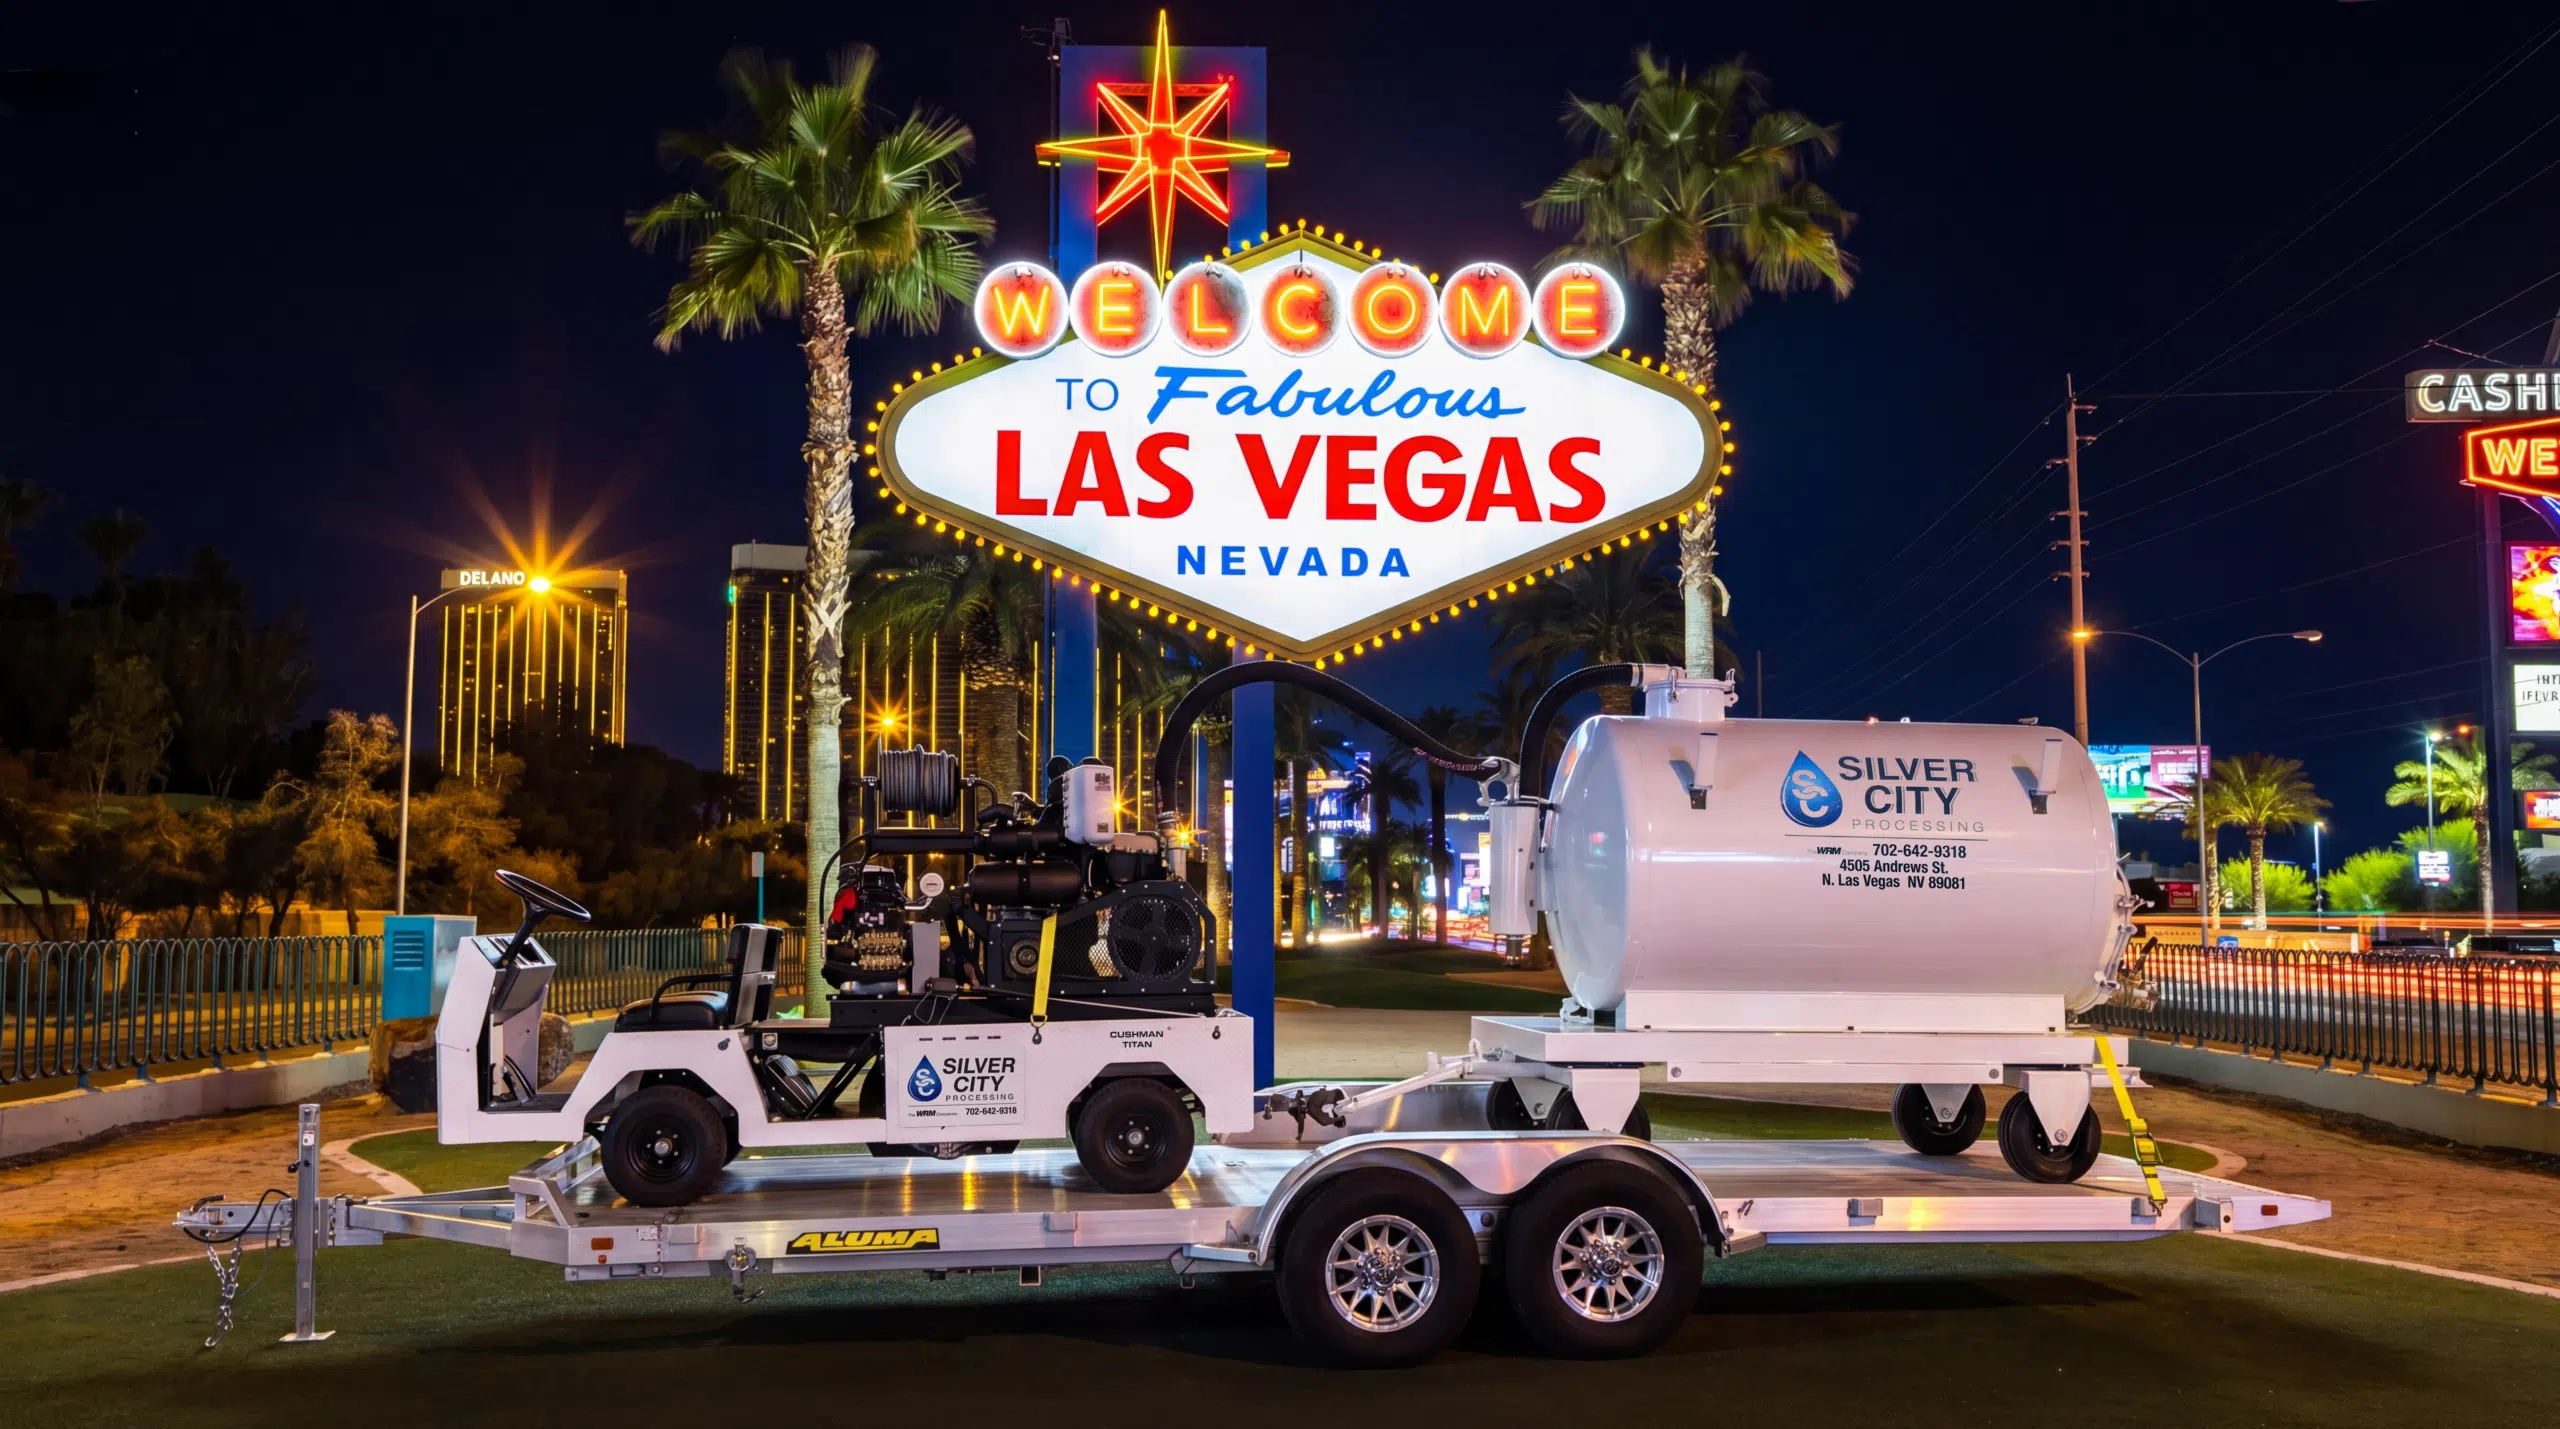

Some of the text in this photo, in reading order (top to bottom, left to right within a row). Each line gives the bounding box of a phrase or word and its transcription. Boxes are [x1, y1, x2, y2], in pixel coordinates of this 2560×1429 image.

[991, 283, 1599, 338] WELCOME
[1055, 365, 1527, 425] TO Fabulous
[2417, 372, 2560, 413] CASH
[2481, 438, 2560, 476] WE
[995, 429, 1607, 524] LAS VEGAS
[1176, 544, 1411, 578] NEVADA
[459, 571, 526, 586] DELANO
[1838, 756, 1979, 783] SILVER
[1864, 784, 1962, 816] CITY
[1851, 818, 1985, 833] PROCESSING
[1816, 846, 1842, 855] WRM
[1872, 843, 1967, 859] 702-642-9318
[1839, 858, 1949, 875] 4505 Andrews St.
[1822, 873, 1966, 890] N. Las Vegas NV 89081
[1109, 1030, 1164, 1039] CUSHMAN
[942, 1057, 1016, 1075] SILVER
[953, 1075, 1005, 1093] CITY
[945, 1093, 1015, 1102] PROCESSING
[916, 1109, 936, 1117] WRM
[965, 1106, 1018, 1116] 702-642-9318
[791, 1228, 939, 1252] ALUMA
